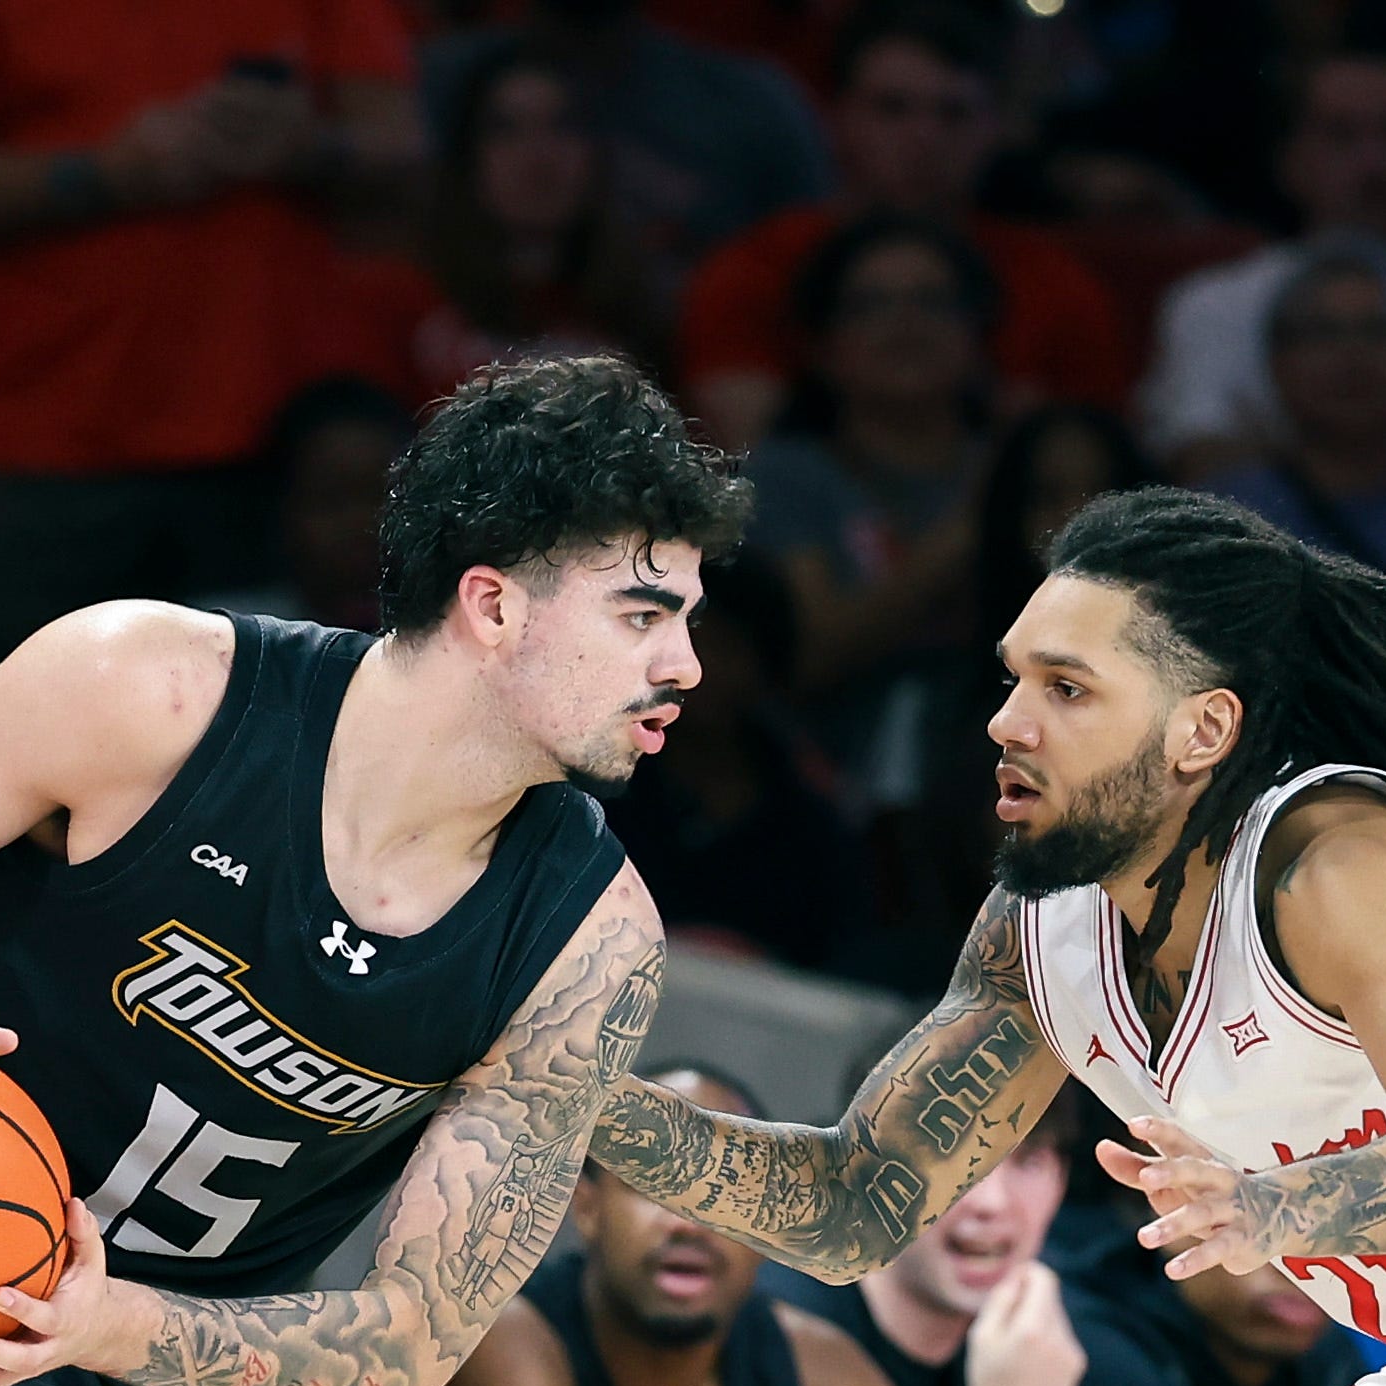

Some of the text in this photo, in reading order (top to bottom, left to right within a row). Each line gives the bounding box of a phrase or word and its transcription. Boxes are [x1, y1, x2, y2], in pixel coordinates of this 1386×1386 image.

[190, 844, 249, 887] CAA
[123, 931, 431, 1128] TOWSON
[84, 1082, 302, 1258] 15
